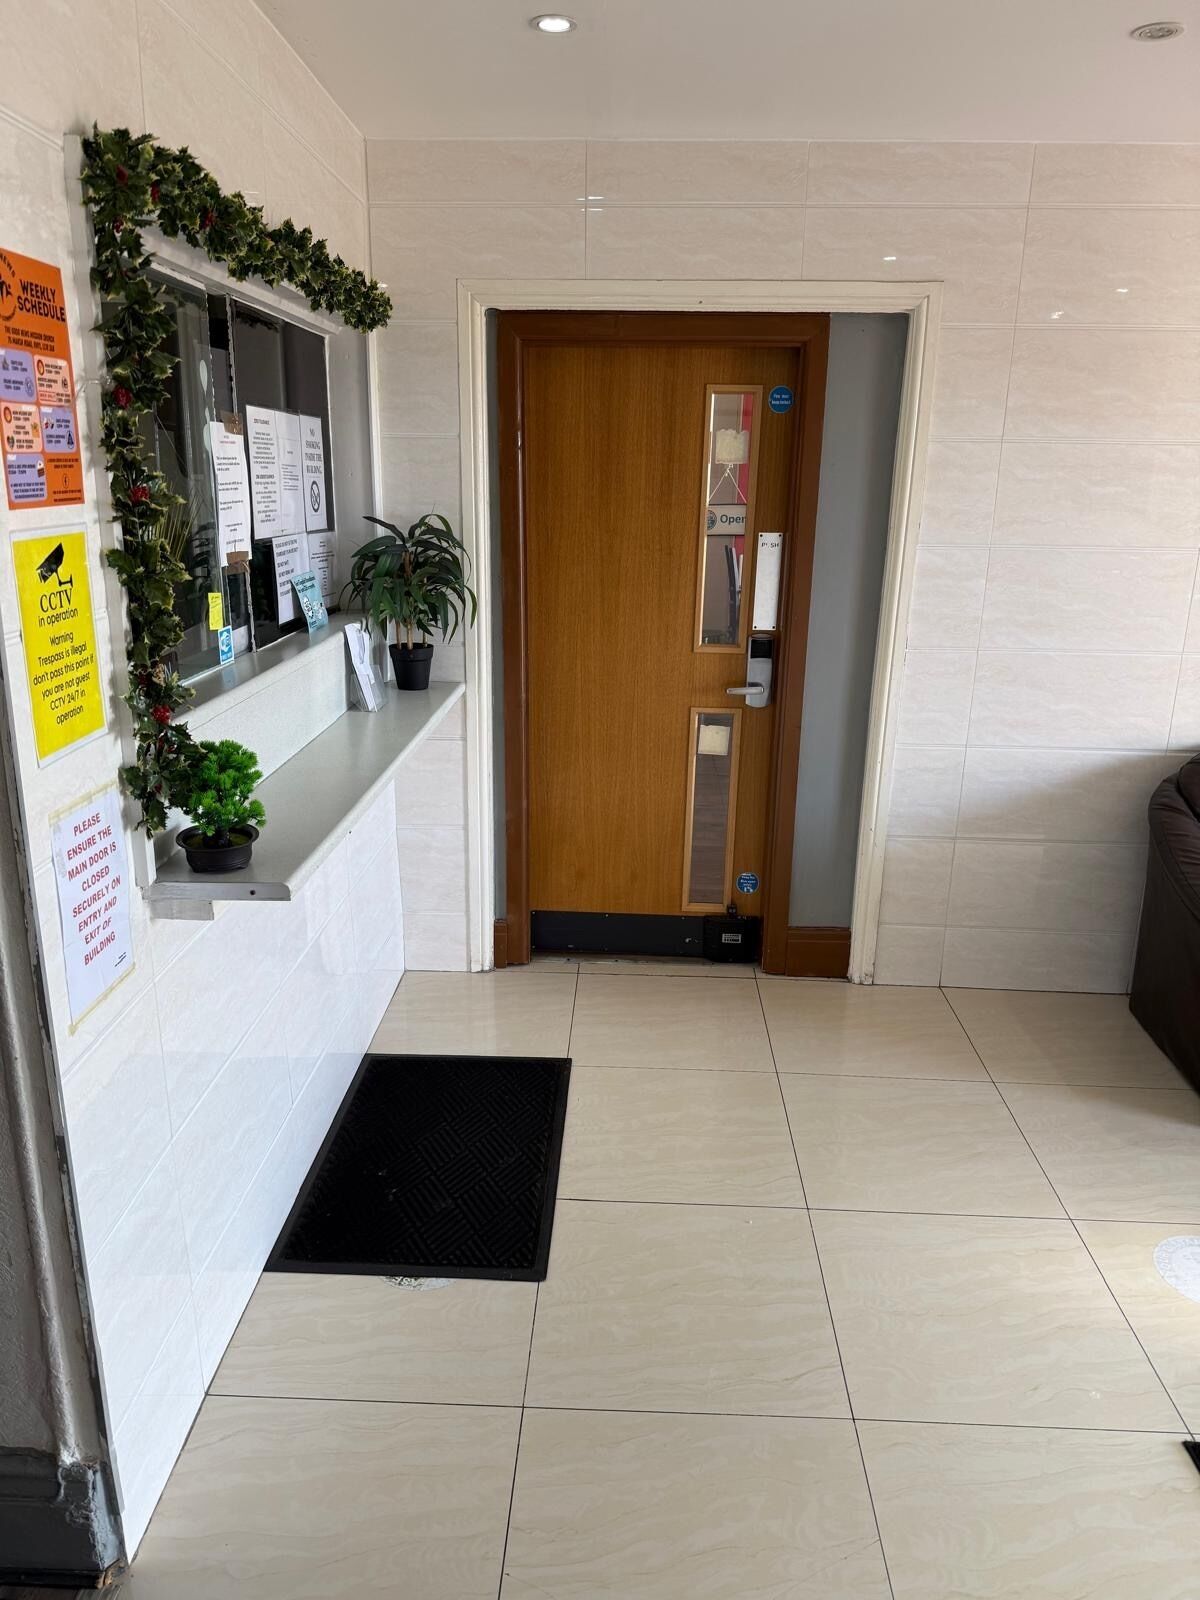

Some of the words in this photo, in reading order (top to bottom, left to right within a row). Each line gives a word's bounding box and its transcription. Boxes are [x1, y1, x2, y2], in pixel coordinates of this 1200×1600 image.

[19, 279, 56, 303] WEEKLY
[16, 295, 66, 322] SCHEDULE
[40, 588, 72, 613] CCTV
[38, 616, 46, 628] in
[46, 608, 79, 627] operation
[49, 632, 74, 647] Warning
[38, 651, 65, 667] Trespass
[65, 648, 71, 658] is
[71, 641, 87, 656] illegal
[33, 672, 50, 686] don't
[49, 667, 65, 682] pass
[64, 662, 75, 674] this
[75, 656, 90, 672] point
[89, 653, 94, 664] if
[42, 687, 54, 701] you
[54, 682, 65, 694] are
[65, 678, 75, 690] not
[75, 672, 91, 687] guest
[50, 695, 66, 711] CCTV
[66, 690, 80, 704] 24/7
[80, 688, 86, 698] in
[56, 705, 84, 726] operation
[73, 812, 102, 837] PLEASE
[67, 834, 98, 861] ENSURE
[97, 825, 112, 841] THE
[67, 860, 88, 882] MAIN
[88, 846, 110, 867] DOOR
[109, 841, 117, 853] IS
[81, 865, 110, 892] CLOSED
[72, 883, 110, 918] SECURELY
[111, 875, 121, 890] ON
[78, 907, 102, 932] ENTRY
[103, 896, 118, 914] AND
[84, 924, 101, 945] EXIT
[102, 916, 112, 931] OF
[84, 931, 116, 966] BUILDING
